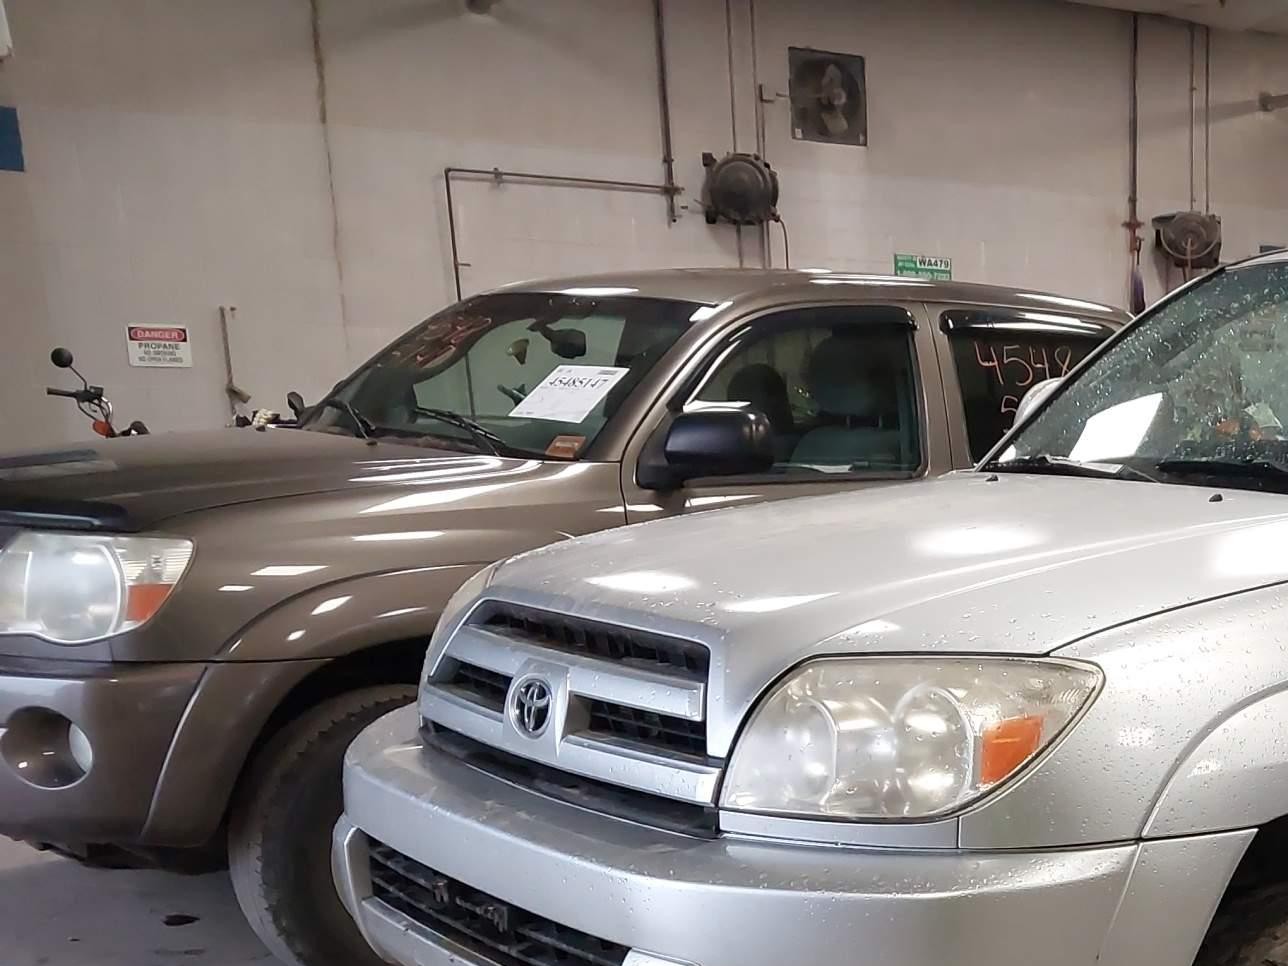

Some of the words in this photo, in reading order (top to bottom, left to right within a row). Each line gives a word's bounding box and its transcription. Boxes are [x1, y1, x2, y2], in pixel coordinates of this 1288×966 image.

[918, 258, 949, 269] WA479
[137, 330, 178, 339] DANGER
[138, 342, 181, 350] PROPANE
[549, 376, 609, 388] 45485147
